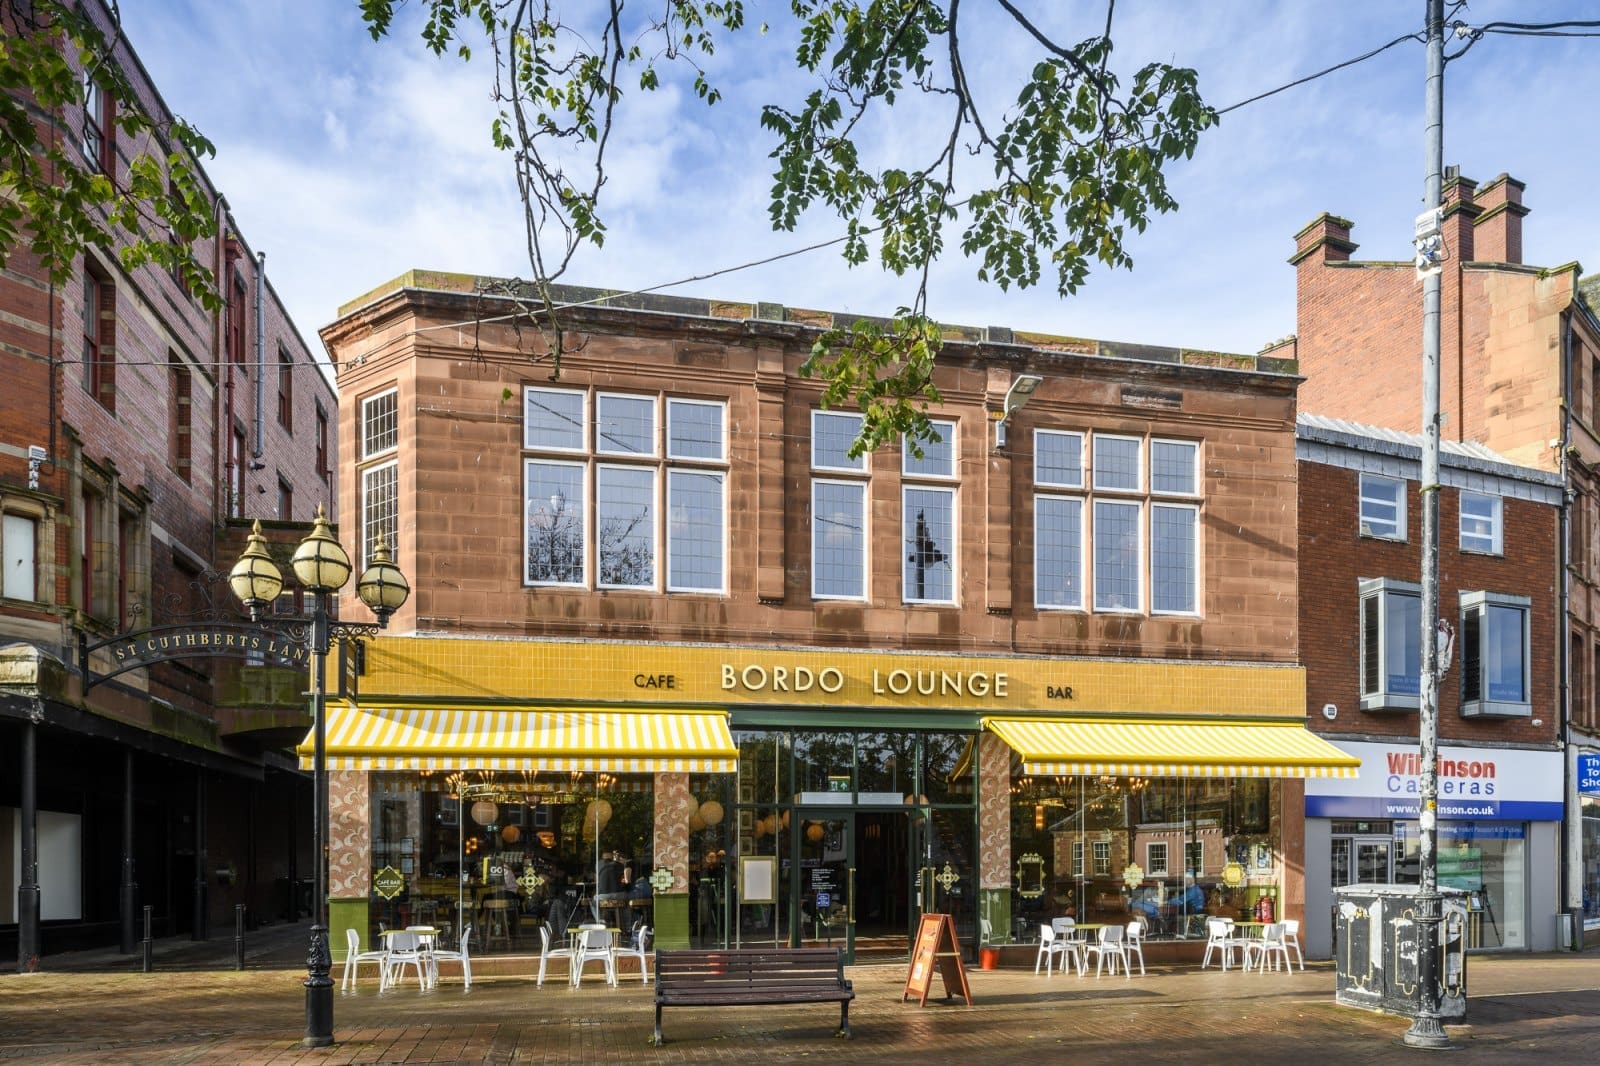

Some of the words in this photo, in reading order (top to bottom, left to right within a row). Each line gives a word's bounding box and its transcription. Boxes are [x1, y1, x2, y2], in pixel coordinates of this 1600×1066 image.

[147, 633, 260, 651] CUTHBERTS
[633, 673, 675, 689] CAFE
[721, 664, 844, 694] BORDO
[872, 668, 1009, 697] LOUNGE
[1047, 685, 1073, 700] BAR
[1386, 752, 1496, 779] Wilinson
[1387, 775, 1495, 795] Caeras
